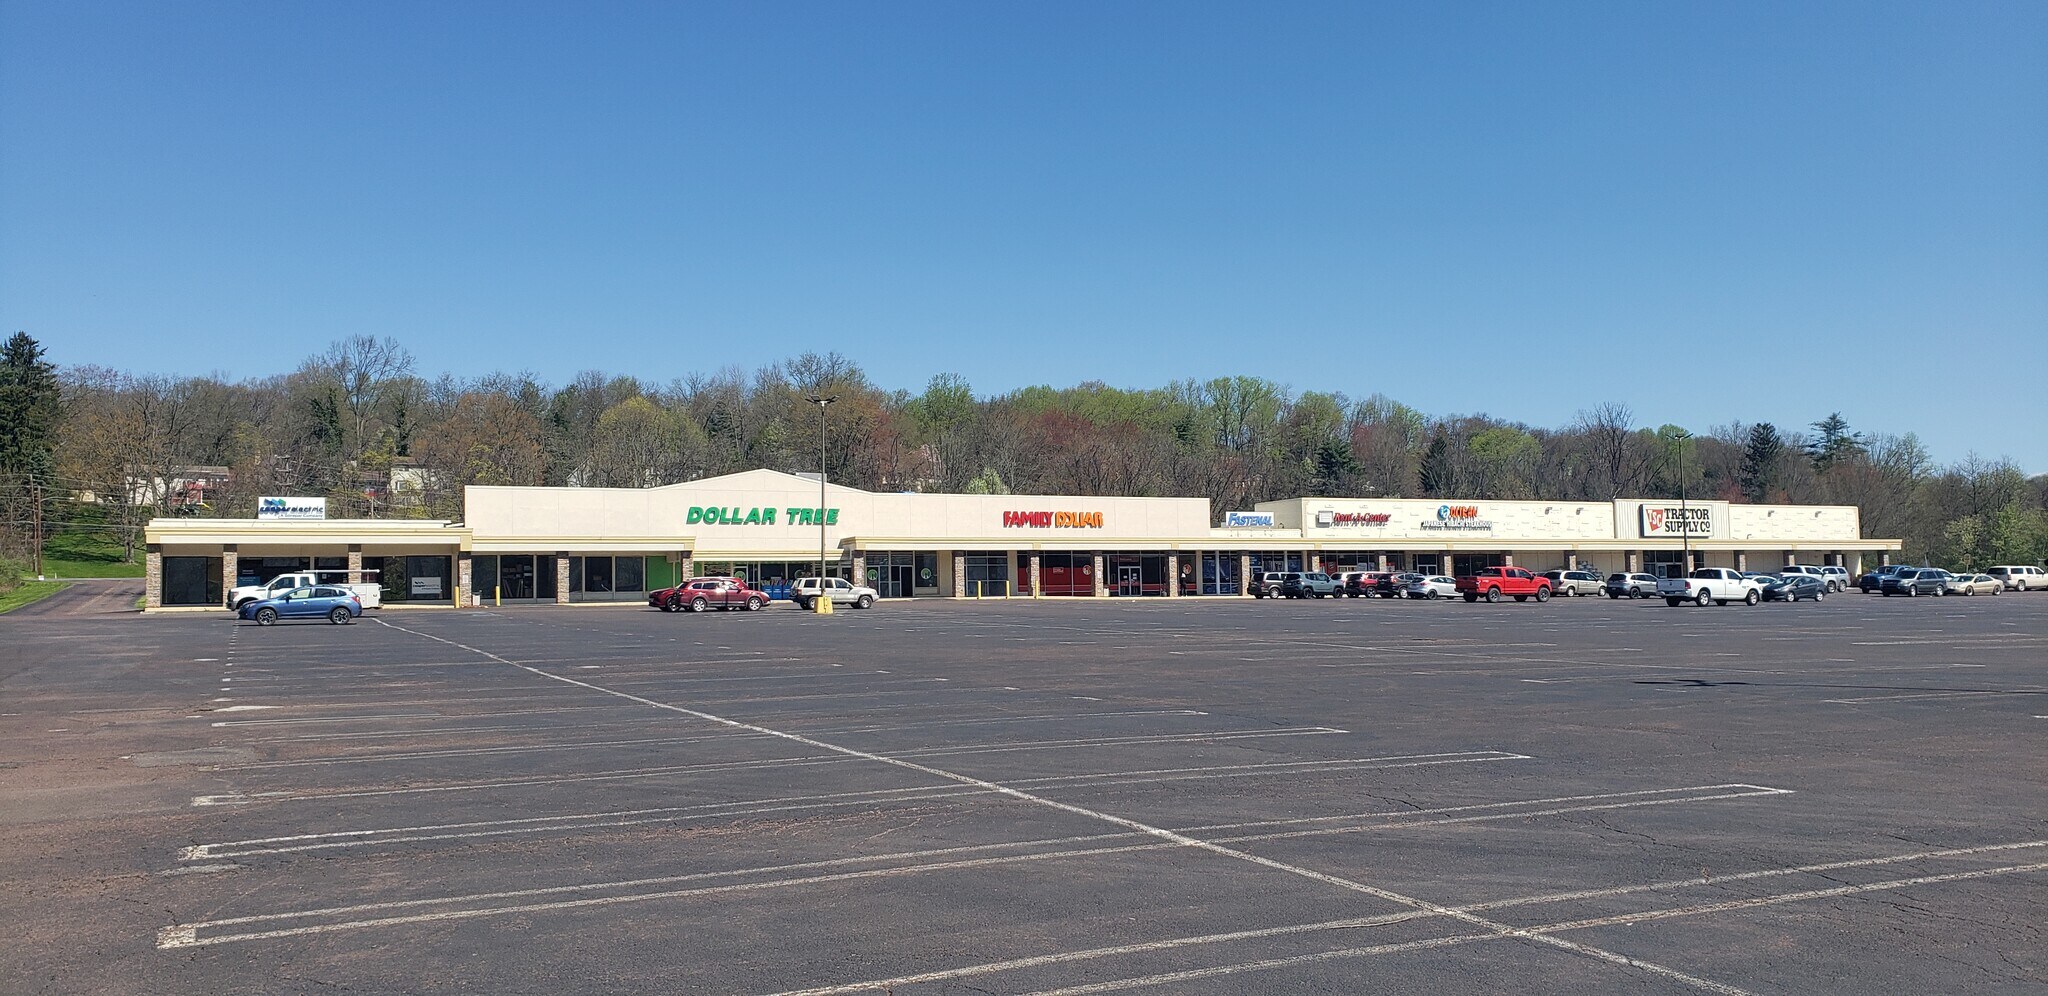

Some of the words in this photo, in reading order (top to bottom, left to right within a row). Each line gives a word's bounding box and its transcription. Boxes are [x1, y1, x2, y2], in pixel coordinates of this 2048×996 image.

[686, 506, 778, 525] DOLLAR
[786, 507, 840, 526] TREE
[1003, 511, 1054, 528] FAMILY
[1055, 511, 1104, 528] DOLLAR
[1647, 509, 1662, 527] TSC
[1664, 508, 1710, 520] TRACTOR
